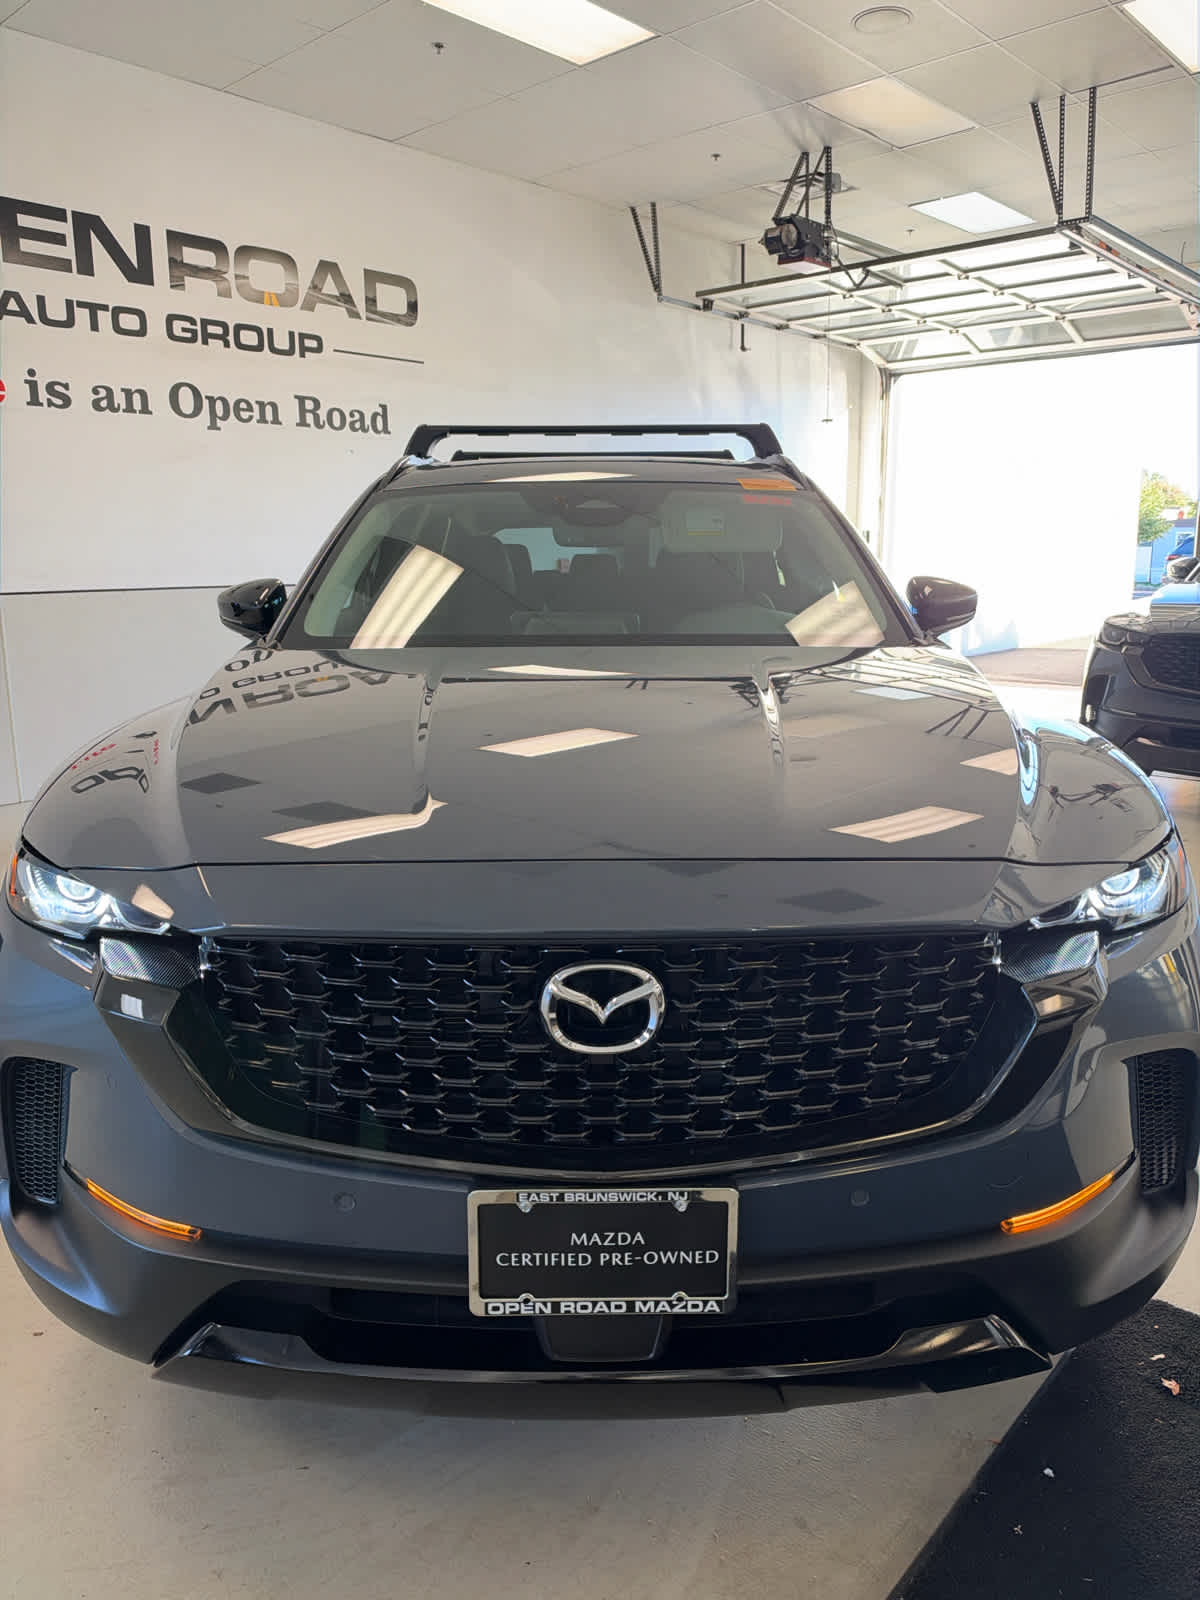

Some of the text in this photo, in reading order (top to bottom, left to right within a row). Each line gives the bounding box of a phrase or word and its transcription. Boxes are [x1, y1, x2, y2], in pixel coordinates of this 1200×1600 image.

[166, 228, 418, 327] ROAD
[0, 290, 323, 358] AUTO GROUP
[24, 368, 72, 409] is
[91, 384, 153, 416] an
[169, 382, 282, 431] Open
[294, 394, 391, 435] Road
[519, 1191, 688, 1203] EAST BRUNSWICK, NJ
[570, 1232, 645, 1246] MAZDA
[495, 1250, 719, 1267] CERTIFIED PRE-OWNED
[487, 1300, 721, 1315] OPEN ROAD MAZDA
